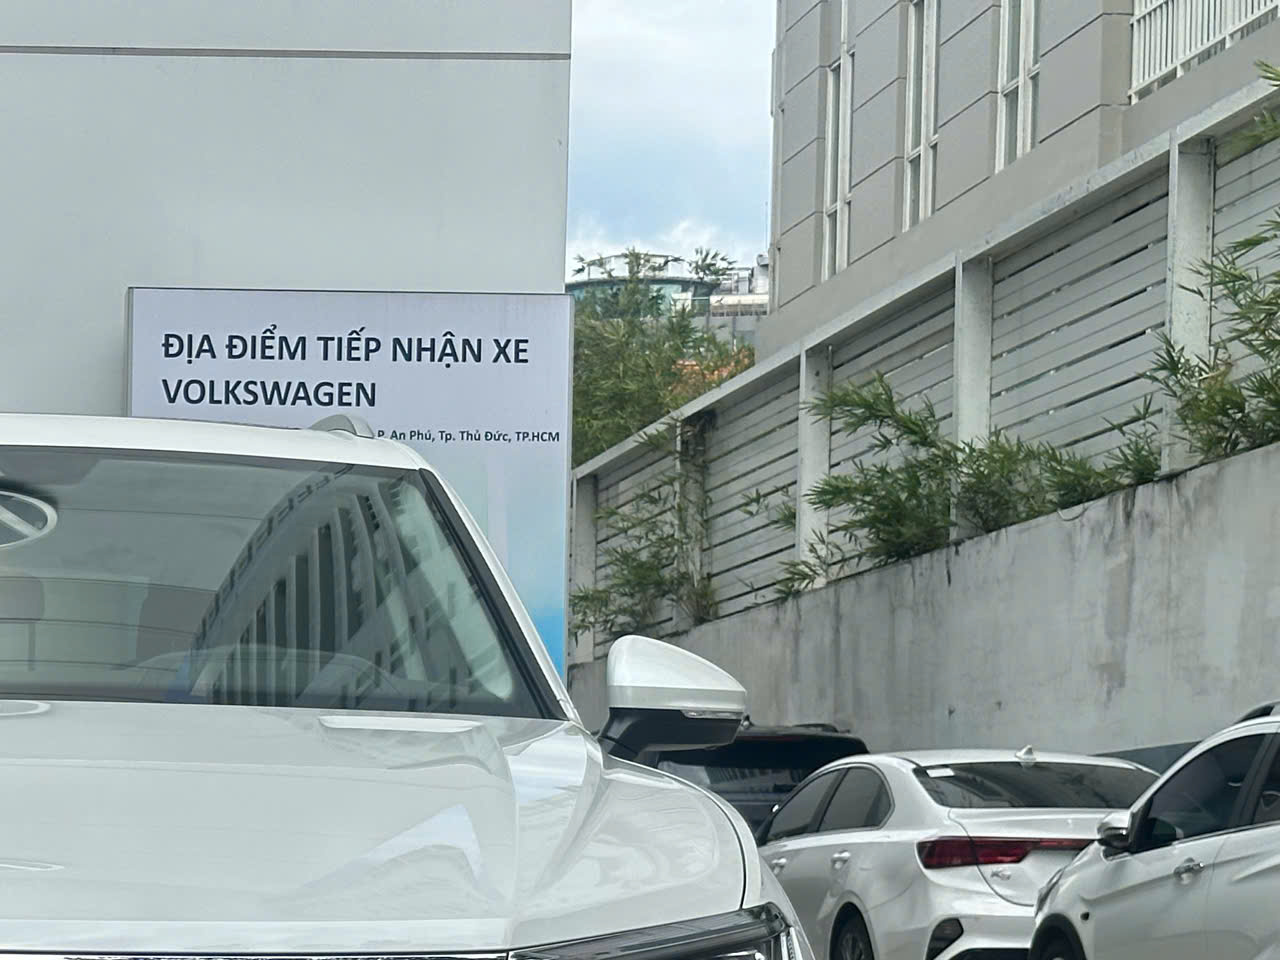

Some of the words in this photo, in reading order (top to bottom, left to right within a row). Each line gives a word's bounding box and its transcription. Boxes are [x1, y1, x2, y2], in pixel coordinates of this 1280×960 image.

[162, 333, 216, 364] ĐỊA
[225, 324, 307, 361] ĐIỂM
[316, 327, 382, 362] TIẾP
[392, 331, 482, 368] NHẬN
[492, 338, 529, 364] XE
[162, 379, 376, 407] VOLKSWAGEN
[390, 429, 406, 440] An
[438, 430, 456, 443] Tp.
[459, 429, 481, 441] Thủ
[484, 430, 511, 443] Đức,
[515, 431, 560, 442] TP.HCM
